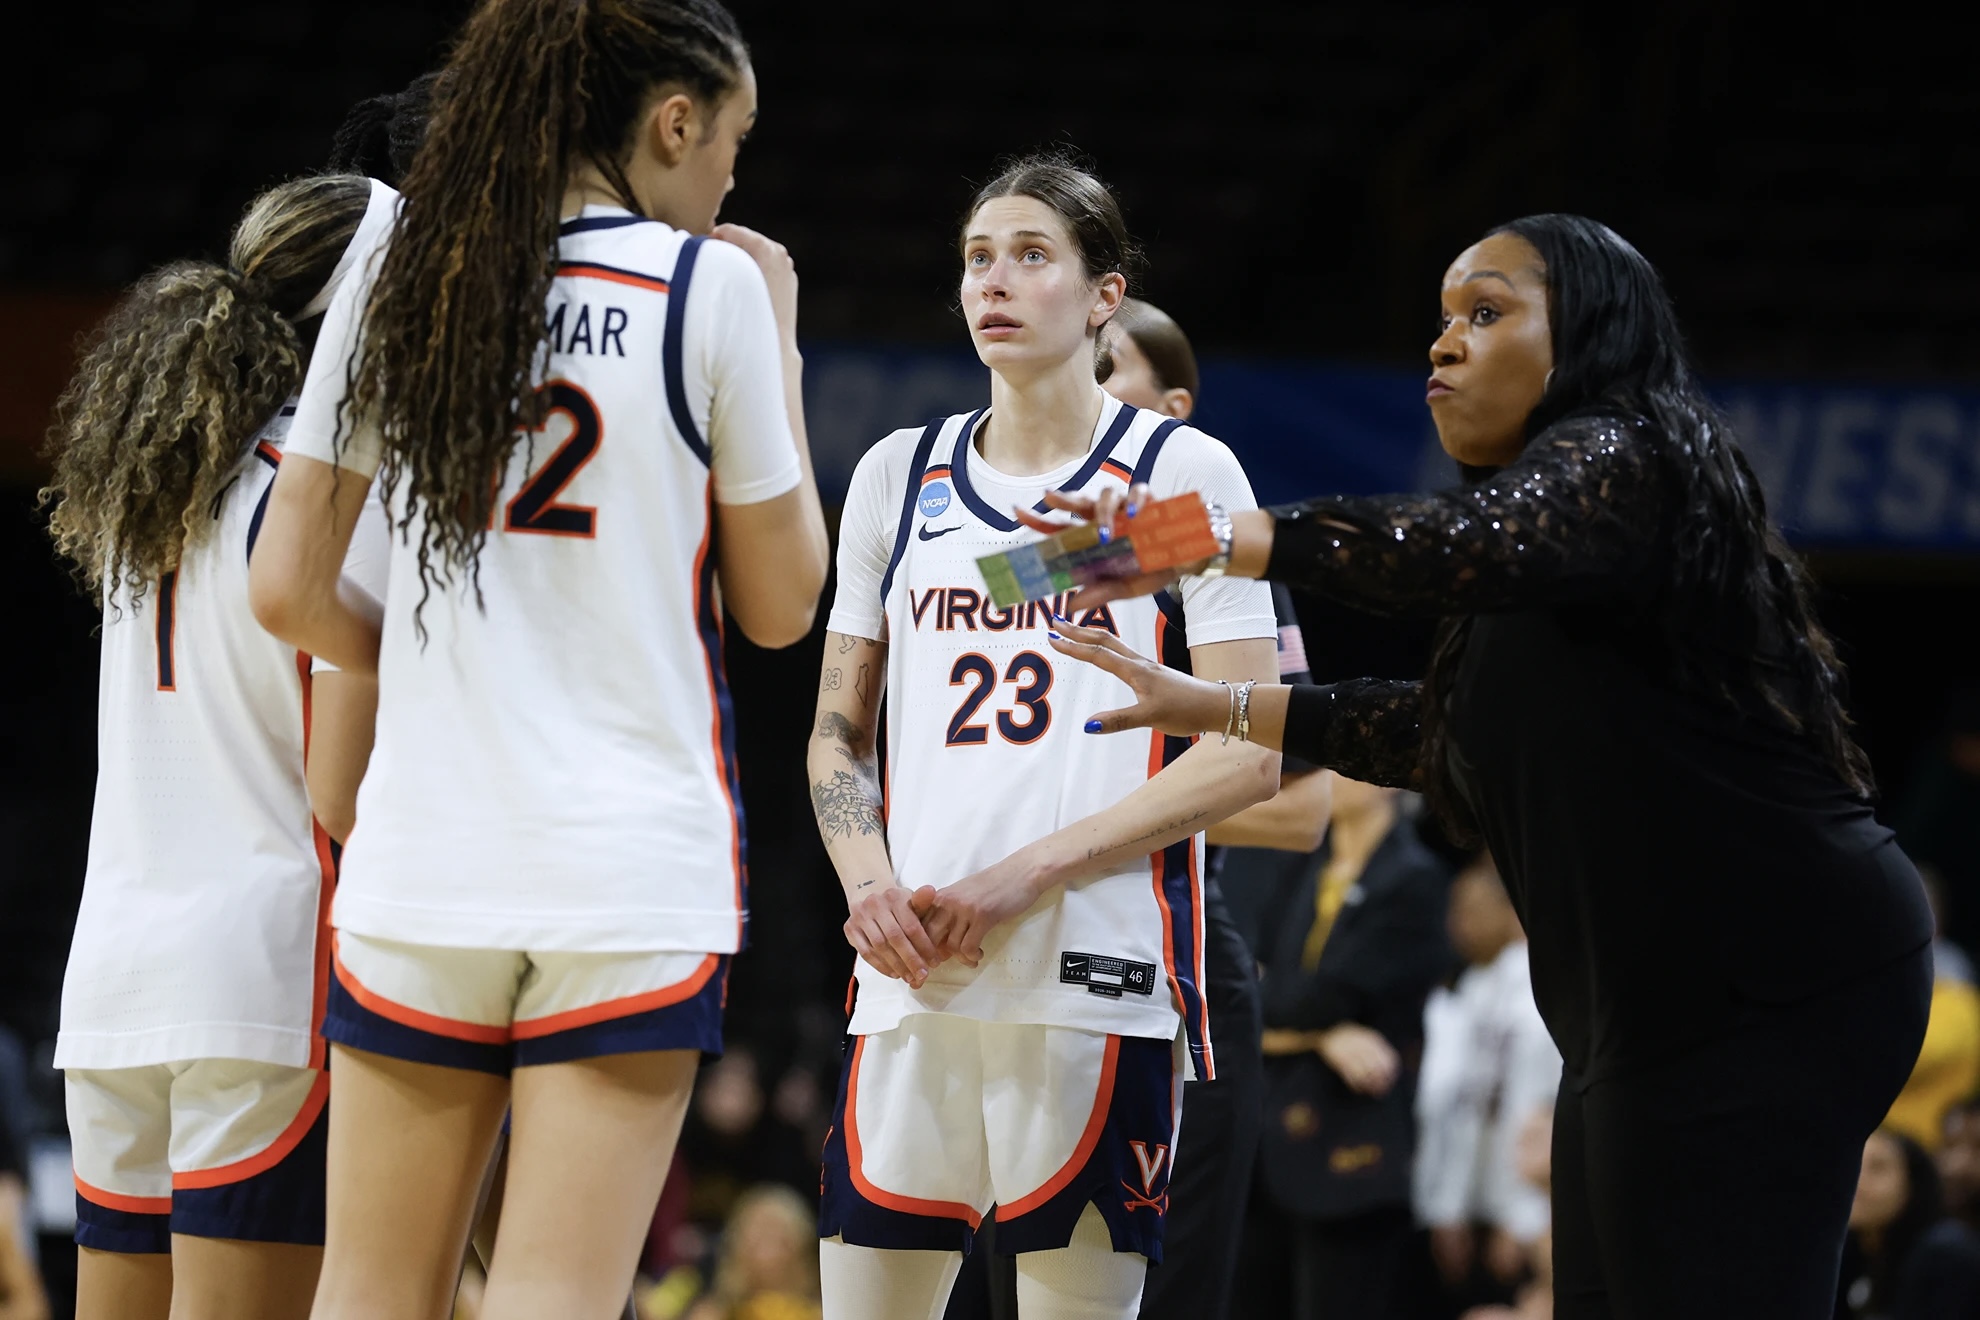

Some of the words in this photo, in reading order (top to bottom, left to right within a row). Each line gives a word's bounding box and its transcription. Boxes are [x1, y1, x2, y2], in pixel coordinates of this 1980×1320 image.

[487, 378, 604, 538] 2
[922, 496, 948, 509] NCAA
[910, 588, 1120, 638] VIRGINIA
[823, 667, 843, 692] 23
[945, 650, 1054, 747] 23
[1129, 970, 1143, 983] 46
[1128, 1141, 1168, 1196] V
